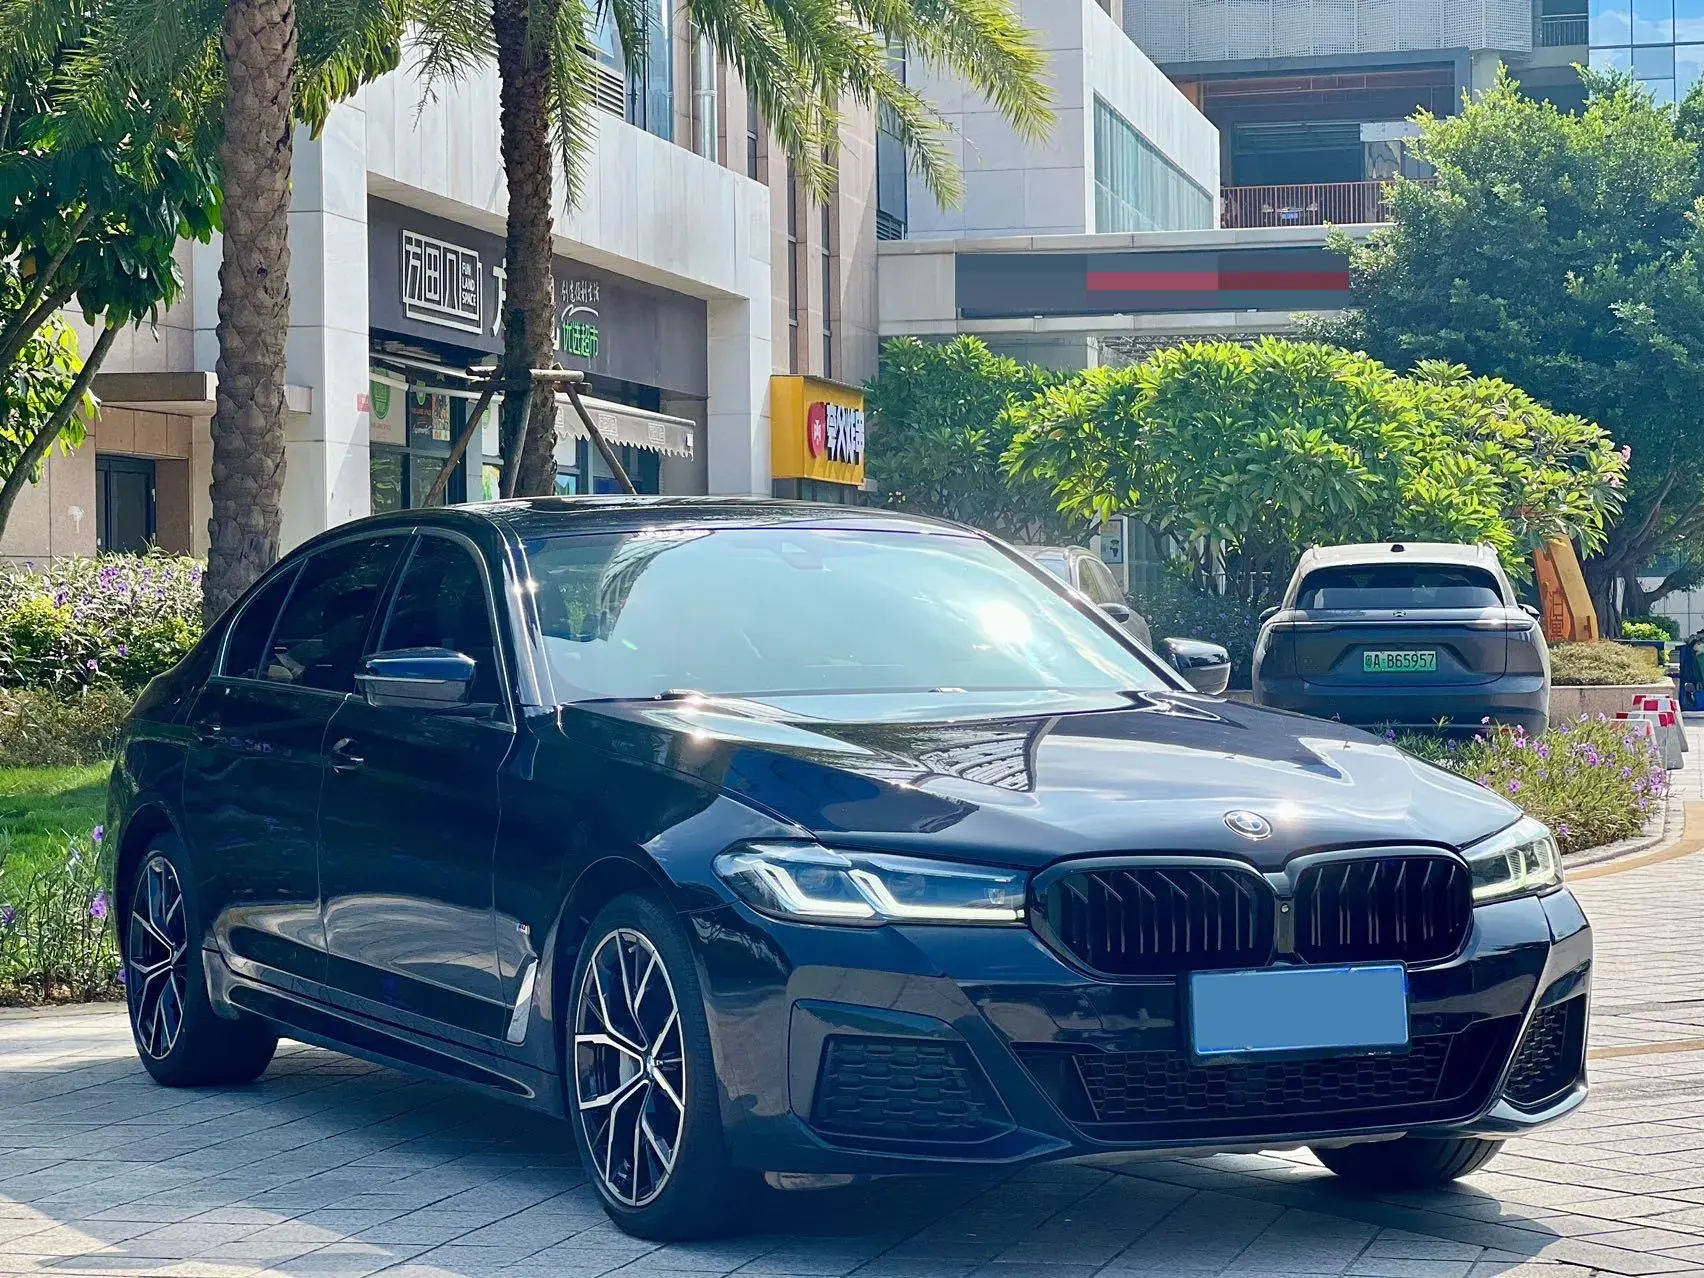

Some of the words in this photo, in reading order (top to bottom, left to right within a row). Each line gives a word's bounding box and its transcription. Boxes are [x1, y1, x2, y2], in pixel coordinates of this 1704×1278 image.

[461, 261, 472, 276] FUN
[461, 277, 476, 292] LAND
[461, 291, 477, 307] SPACE
